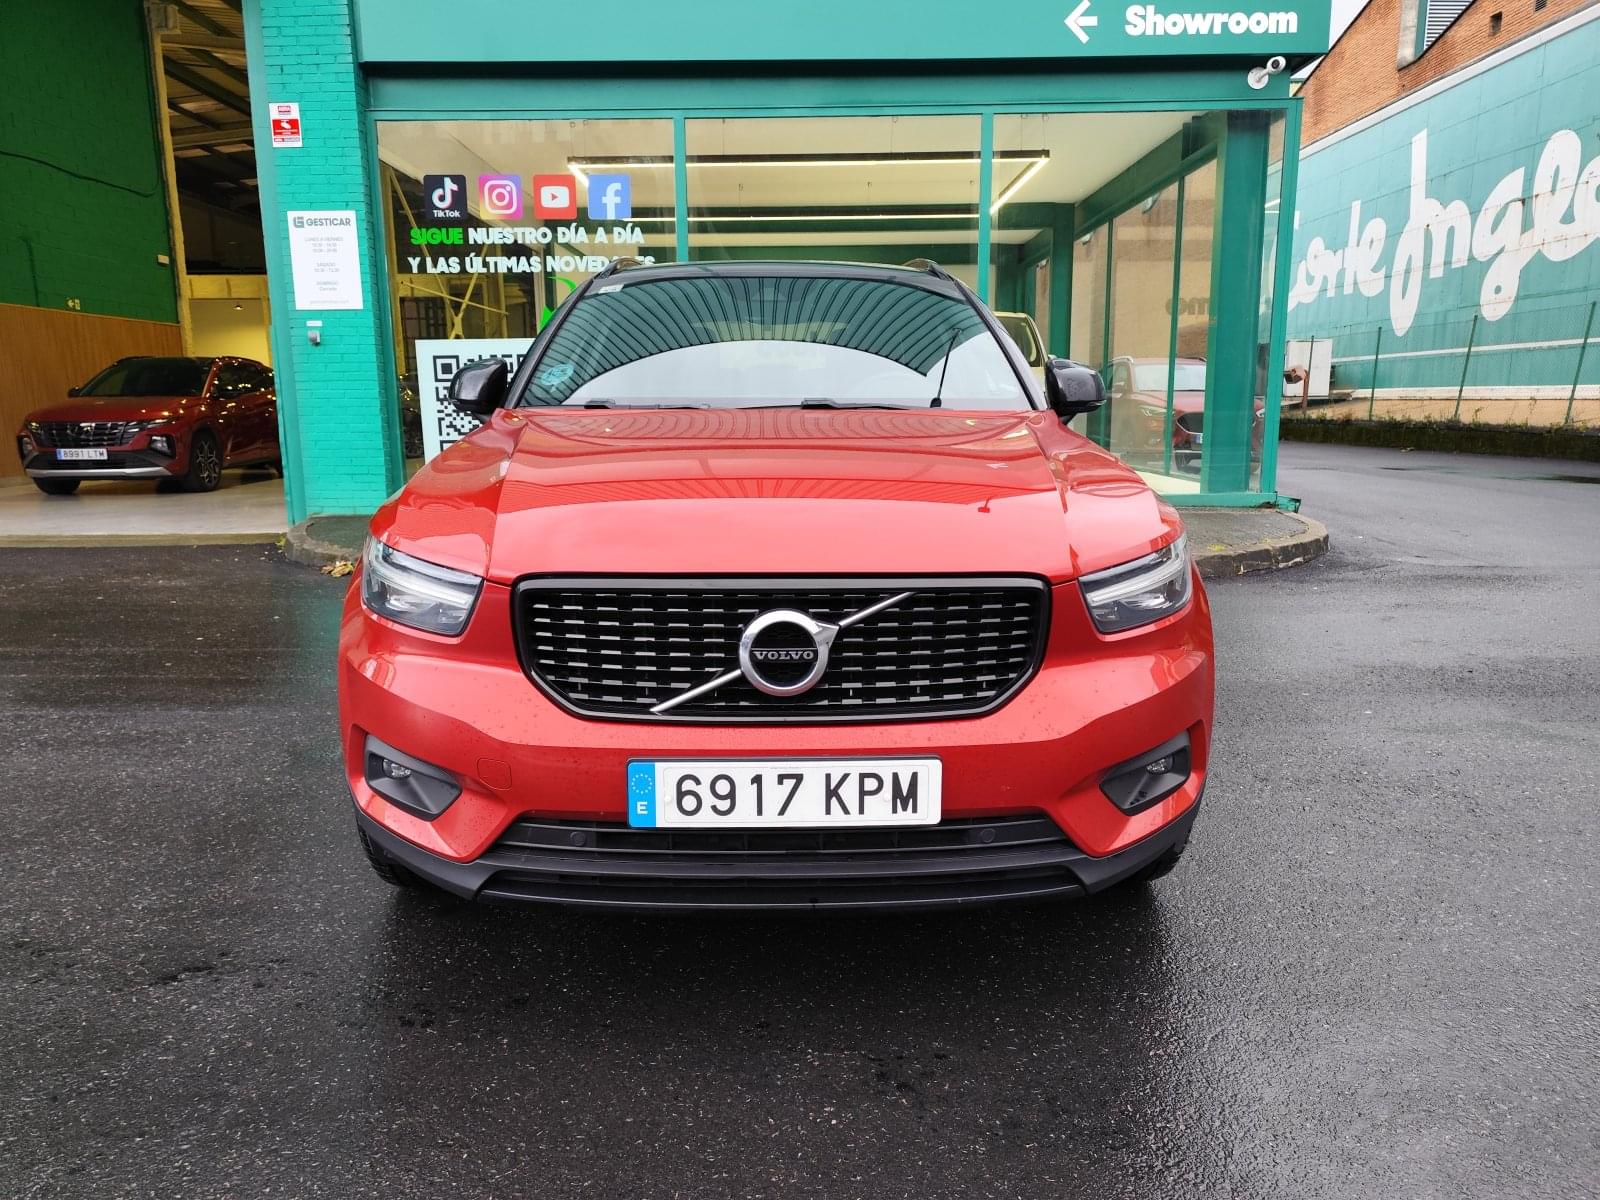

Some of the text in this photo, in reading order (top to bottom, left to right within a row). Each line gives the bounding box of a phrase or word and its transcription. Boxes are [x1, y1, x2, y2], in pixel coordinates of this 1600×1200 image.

[1125, 4, 1298, 36] Showroom
[305, 217, 351, 227] GESTICAR
[433, 210, 461, 218] TikTok
[410, 222, 645, 244] SIGUE NUESTRO DÍA A DÍA
[407, 256, 421, 274] Y
[425, 256, 461, 274] LAS
[465, 252, 542, 274] ÚLTIMAS
[752, 650, 814, 660] VOLVO
[675, 771, 919, 817] 6917 KPM
[636, 801, 648, 815] E
